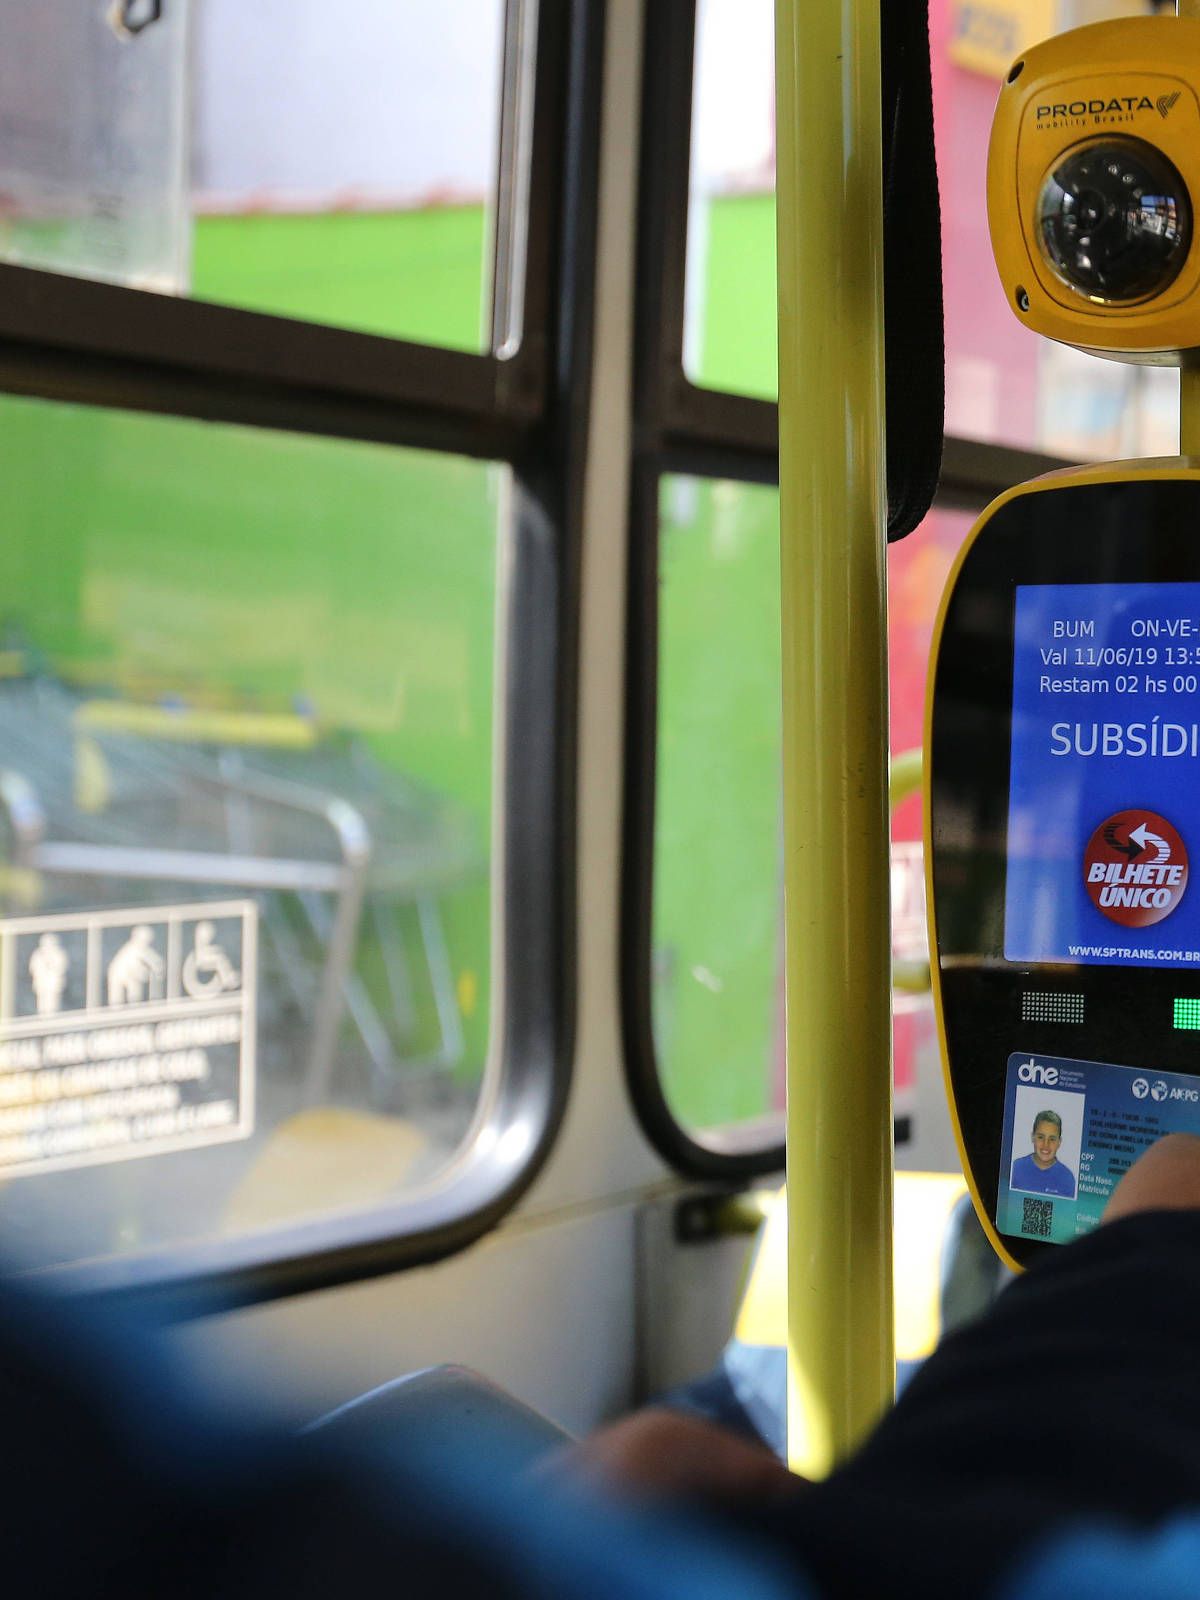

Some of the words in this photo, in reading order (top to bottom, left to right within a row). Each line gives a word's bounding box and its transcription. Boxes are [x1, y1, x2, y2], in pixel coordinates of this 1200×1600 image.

[1037, 97, 1154, 121] PRODATA
[1036, 119, 1086, 130] mobility
[1094, 113, 1134, 124] Brasil
[1053, 621, 1095, 637] BUM
[1040, 648, 1067, 665] Val
[1074, 648, 1157, 667] 11/06/19
[1040, 676, 1109, 693] Restam
[1115, 676, 1139, 693] 02
[1145, 675, 1167, 693] hs
[1173, 676, 1197, 693] 00
[1087, 862, 1184, 885] BILHETE
[1099, 882, 1172, 908] ÚNICO
[1068, 946, 1200, 962] WWW.SPTRANS.COM.BR
[1018, 1058, 1059, 1086] dne
[1081, 1152, 1095, 1161] CPF
[1080, 1163, 1090, 1171] RG
[1079, 1173, 1094, 1182] Data
